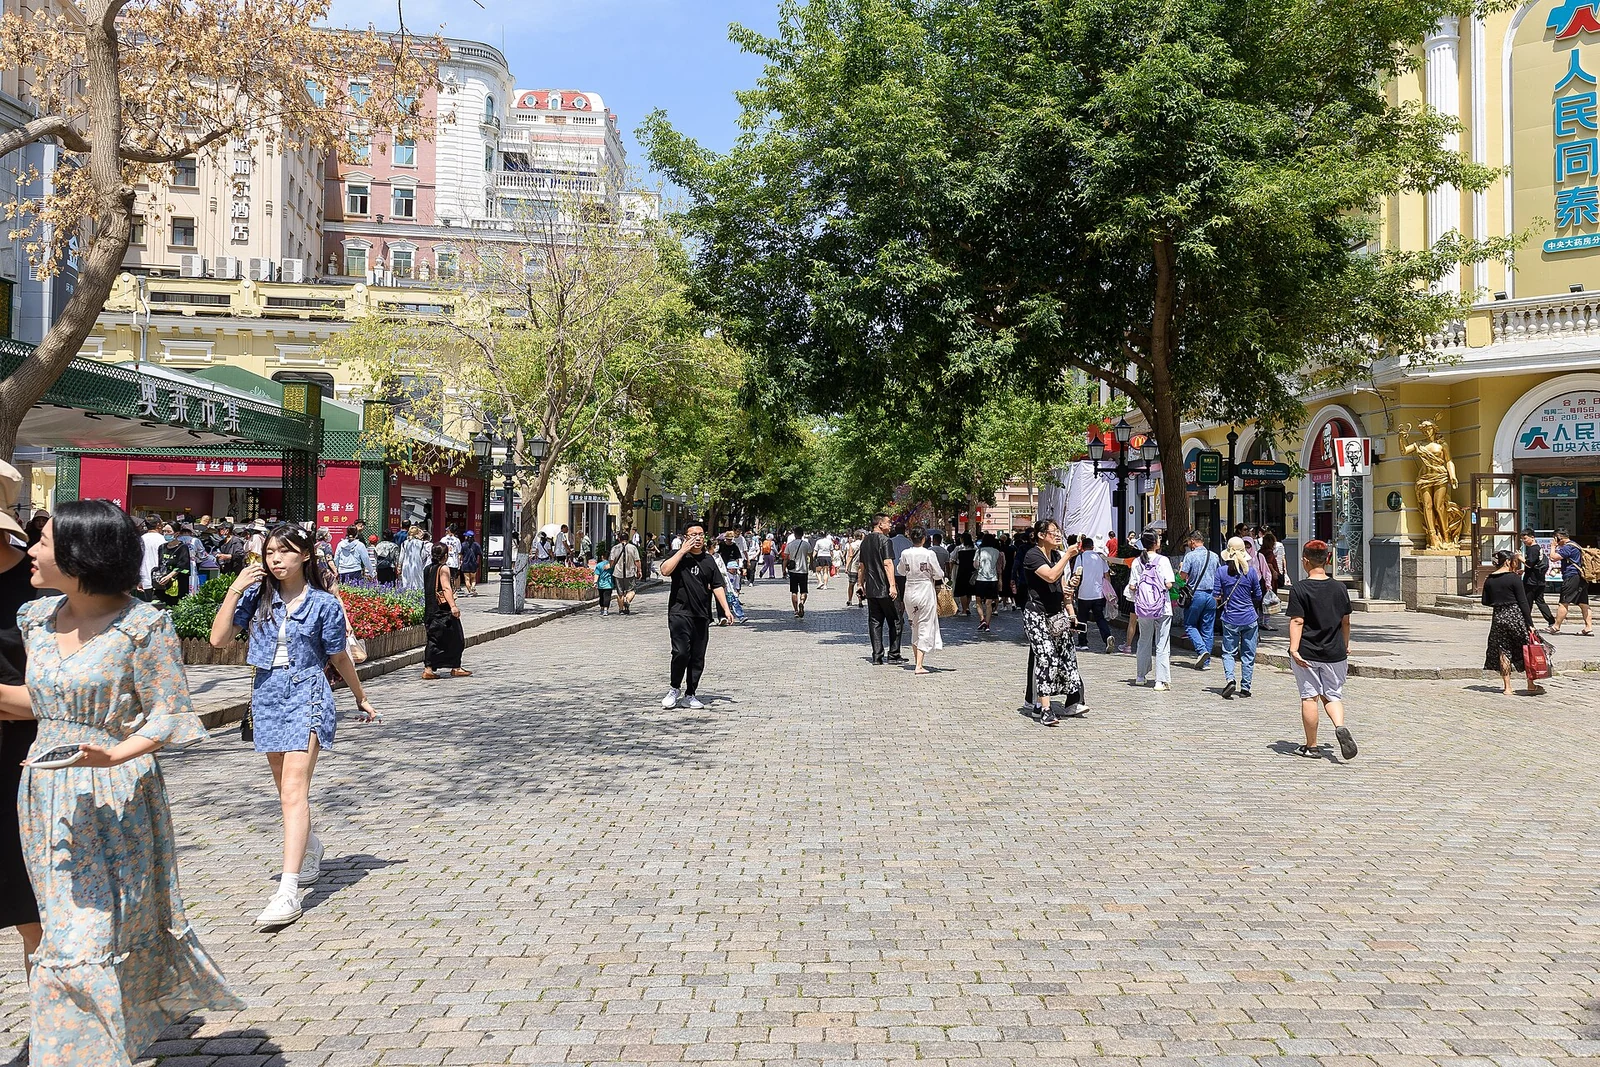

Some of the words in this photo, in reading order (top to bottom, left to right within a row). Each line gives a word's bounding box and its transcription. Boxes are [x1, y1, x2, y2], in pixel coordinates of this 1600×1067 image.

[1554, 48, 1599, 228] 人民同泰
[1552, 422, 1600, 442] 人民
[195, 461, 248, 473] 真丝服饰
